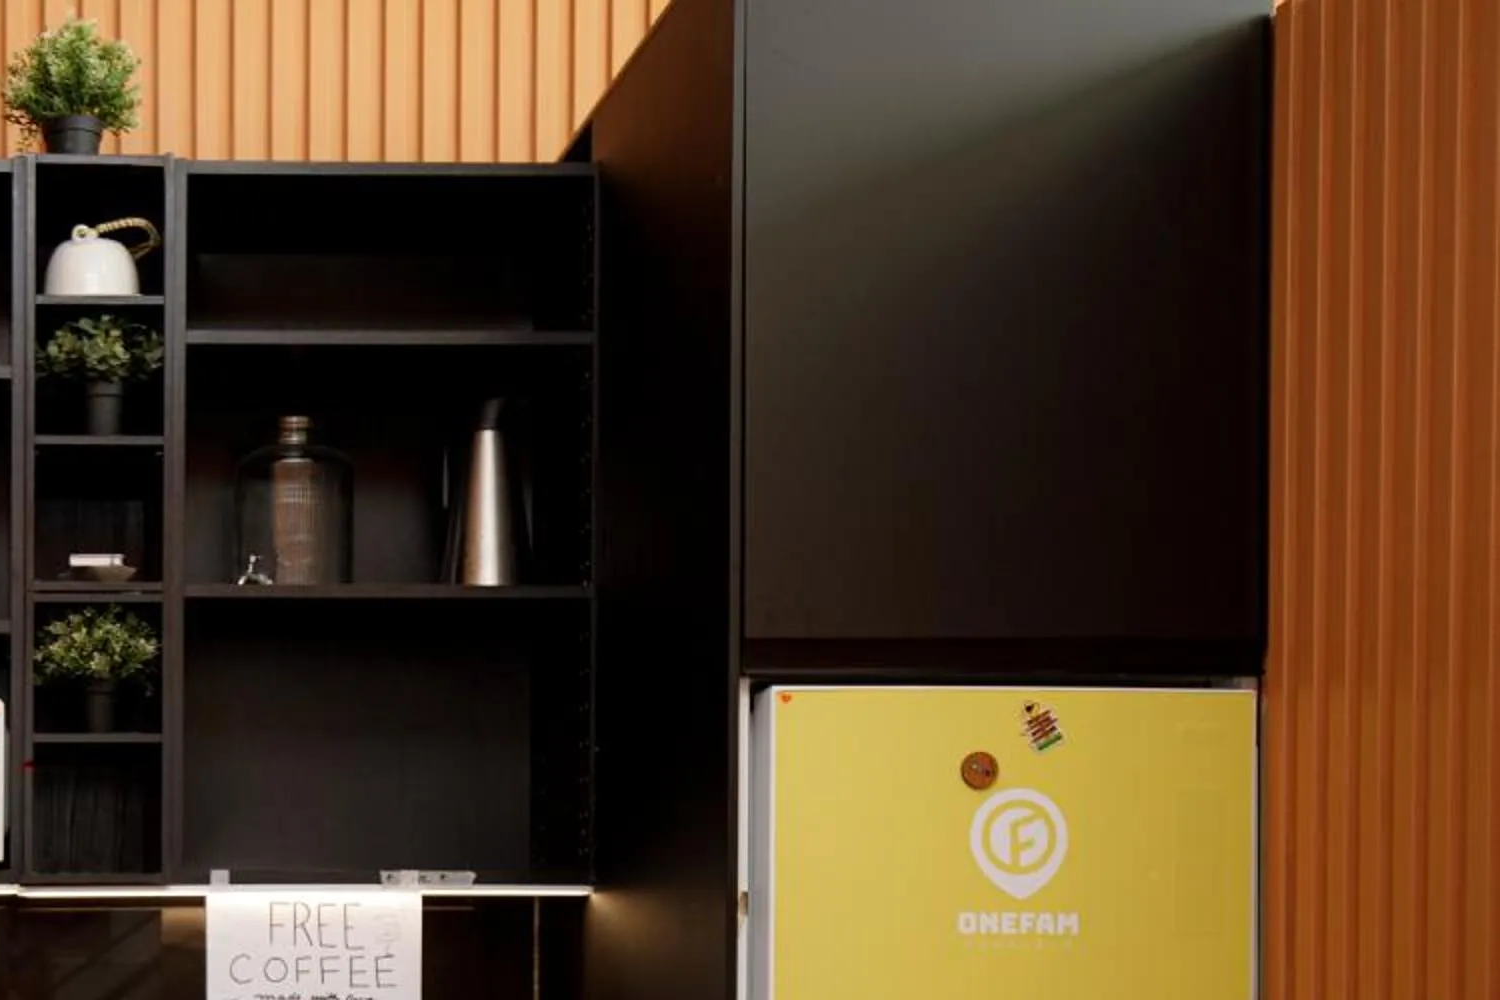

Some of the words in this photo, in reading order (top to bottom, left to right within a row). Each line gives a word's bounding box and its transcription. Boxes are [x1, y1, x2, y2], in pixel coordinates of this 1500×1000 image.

[269, 901, 365, 950] FREE
[958, 911, 1079, 936] ONEFAM
[229, 953, 398, 989] COFFEE
